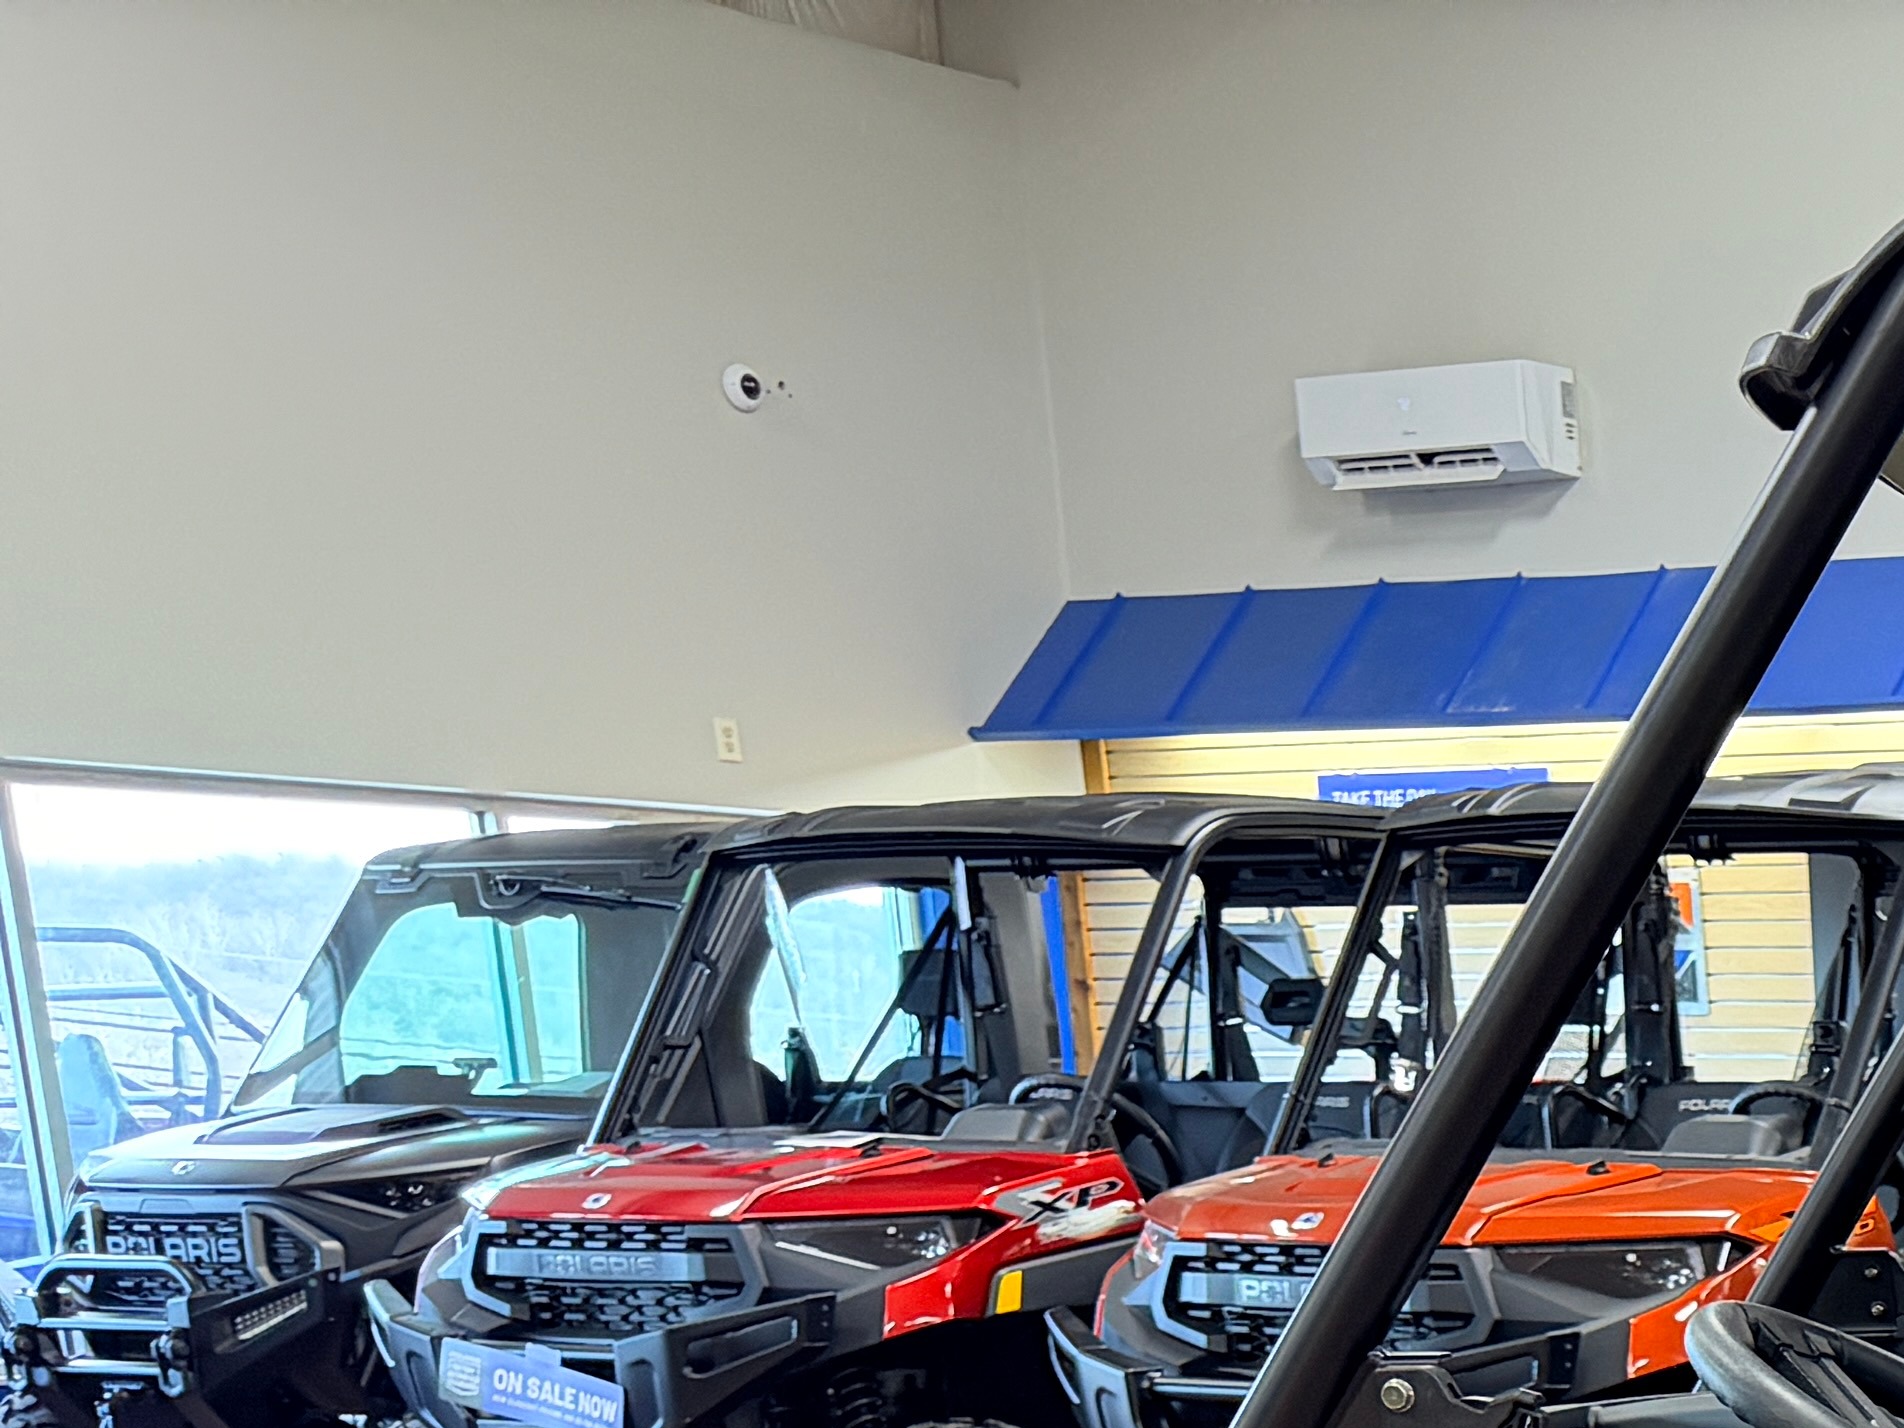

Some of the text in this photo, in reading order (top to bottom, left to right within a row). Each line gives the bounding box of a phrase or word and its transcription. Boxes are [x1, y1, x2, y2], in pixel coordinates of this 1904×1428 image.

[106, 1236, 242, 1262] POLARIS
[493, 1368, 523, 1396] ON
[526, 1376, 576, 1411] SALE
[578, 1392, 618, 1424] NOW
